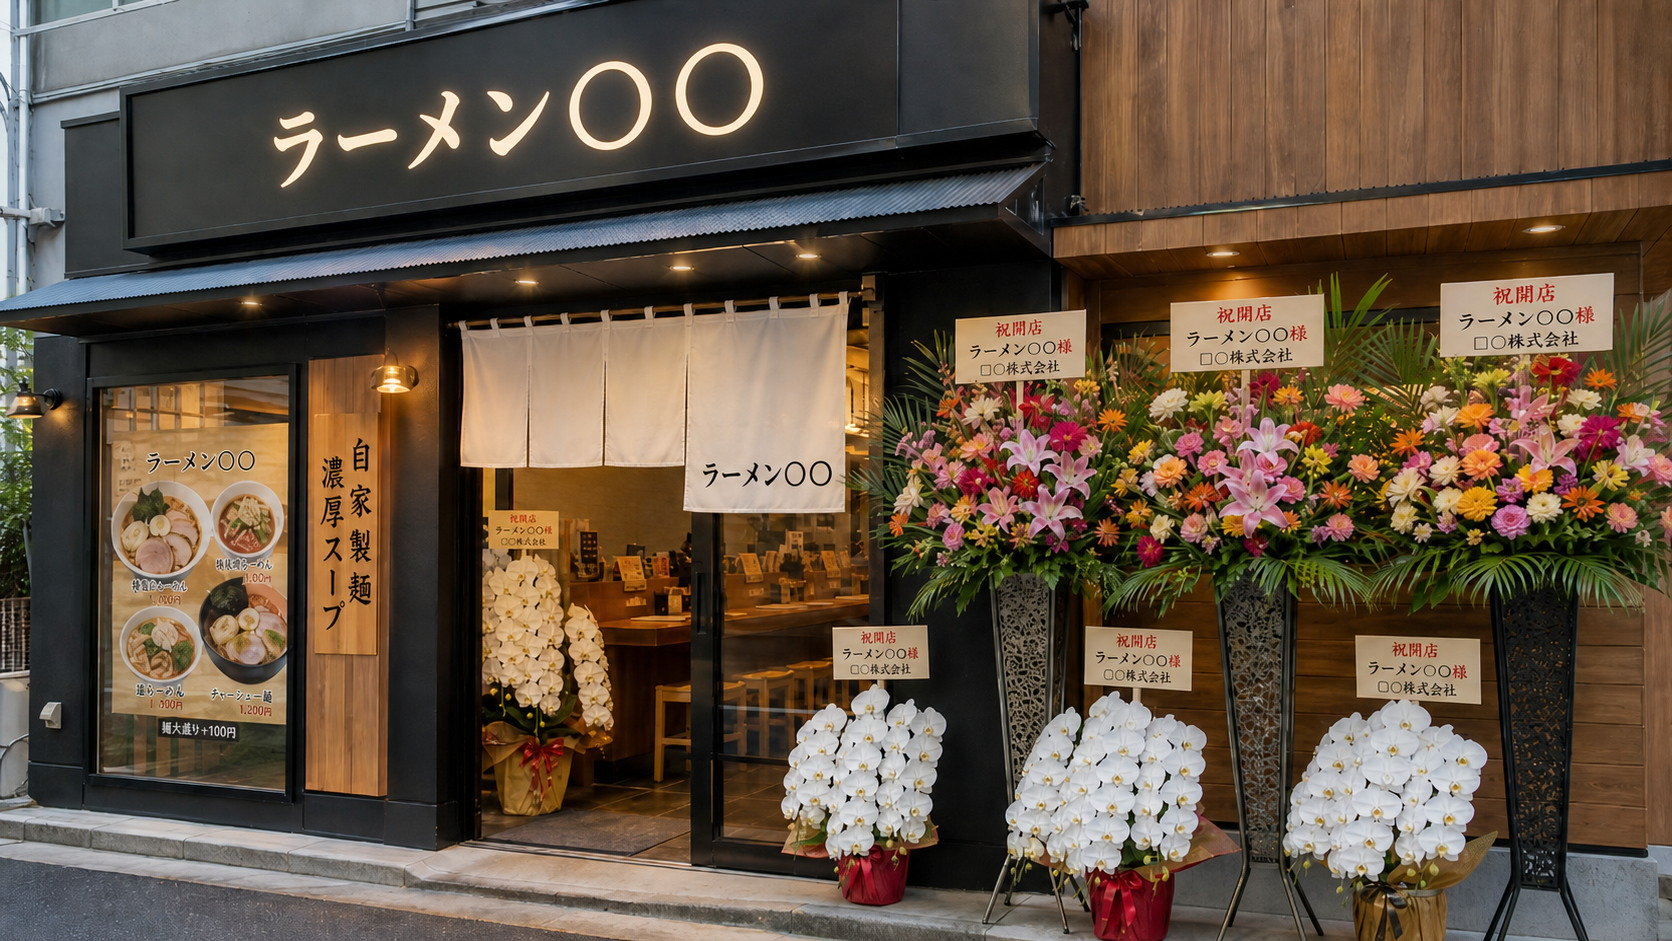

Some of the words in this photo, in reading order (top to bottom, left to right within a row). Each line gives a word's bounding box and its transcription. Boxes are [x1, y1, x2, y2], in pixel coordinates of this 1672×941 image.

[274, 43, 764, 188] ラーメン○○
[1493, 283, 1556, 305] 祝開店
[1217, 304, 1272, 323] 祝開店
[995, 319, 1043, 338] 祝開店
[702, 461, 833, 488] ラーメン○○
[348, 438, 373, 605] 自家製麺
[320, 456, 346, 631] 濃厚スープ
[861, 631, 896, 644] 祝開店
[1116, 633, 1158, 649] 祝開店
[1392, 642, 1438, 658] 祝開店
